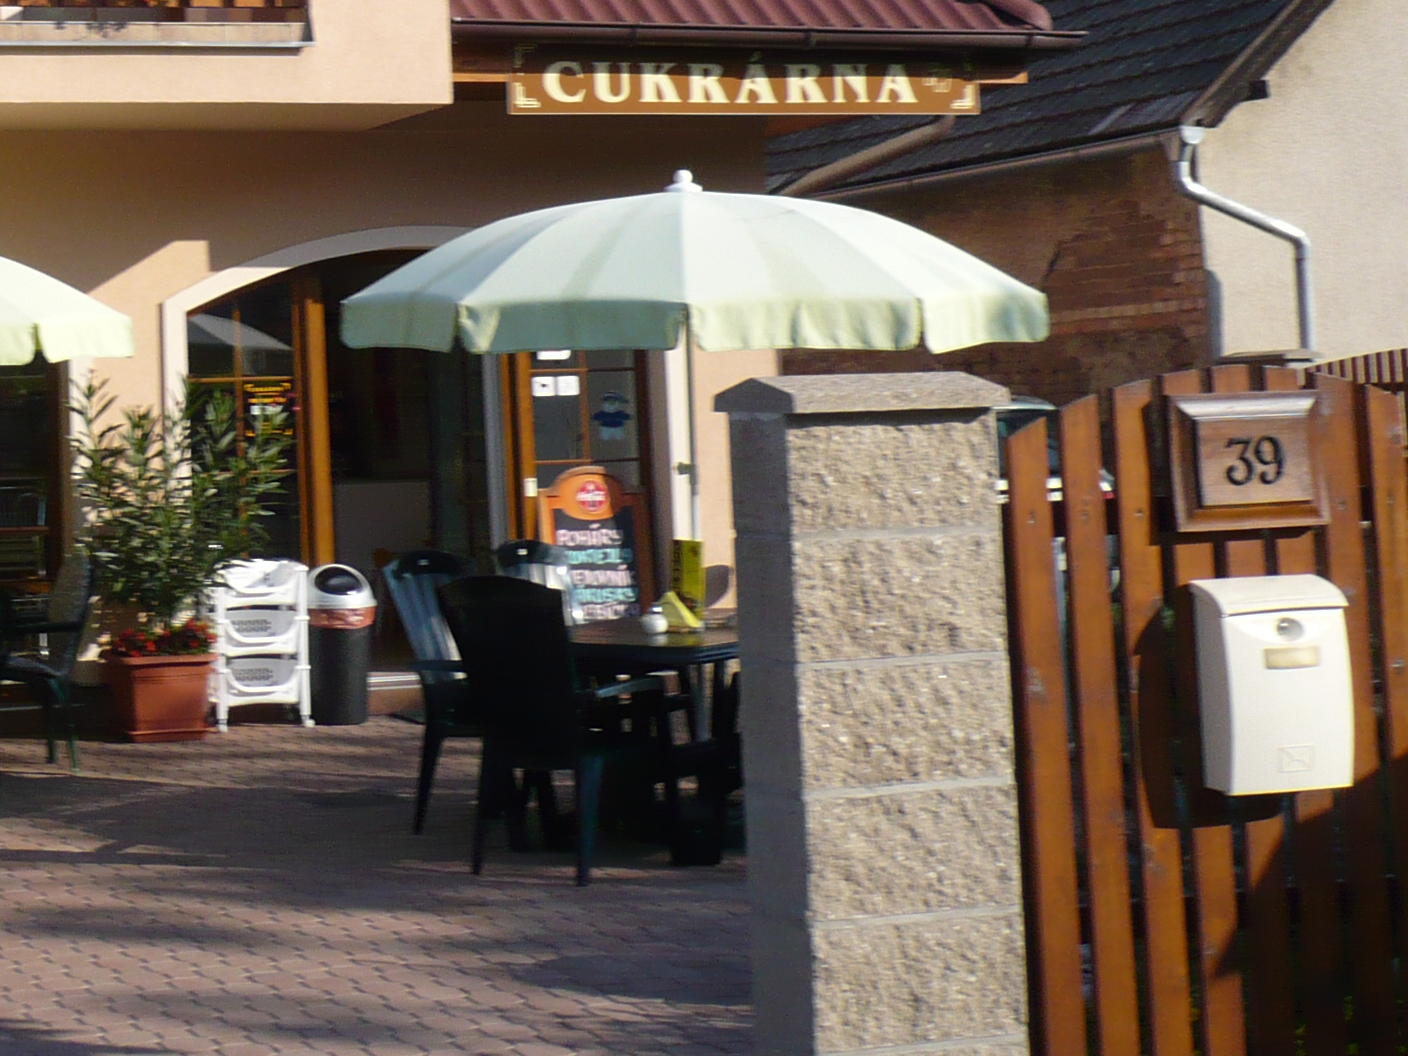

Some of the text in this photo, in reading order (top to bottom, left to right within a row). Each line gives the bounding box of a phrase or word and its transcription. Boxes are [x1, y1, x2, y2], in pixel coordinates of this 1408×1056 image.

[542, 51, 919, 104] CUKRÁRNA
[1224, 435, 1286, 486] 39
[555, 523, 624, 546] POHÁRY
[573, 583, 638, 603] ÁKUSKY
